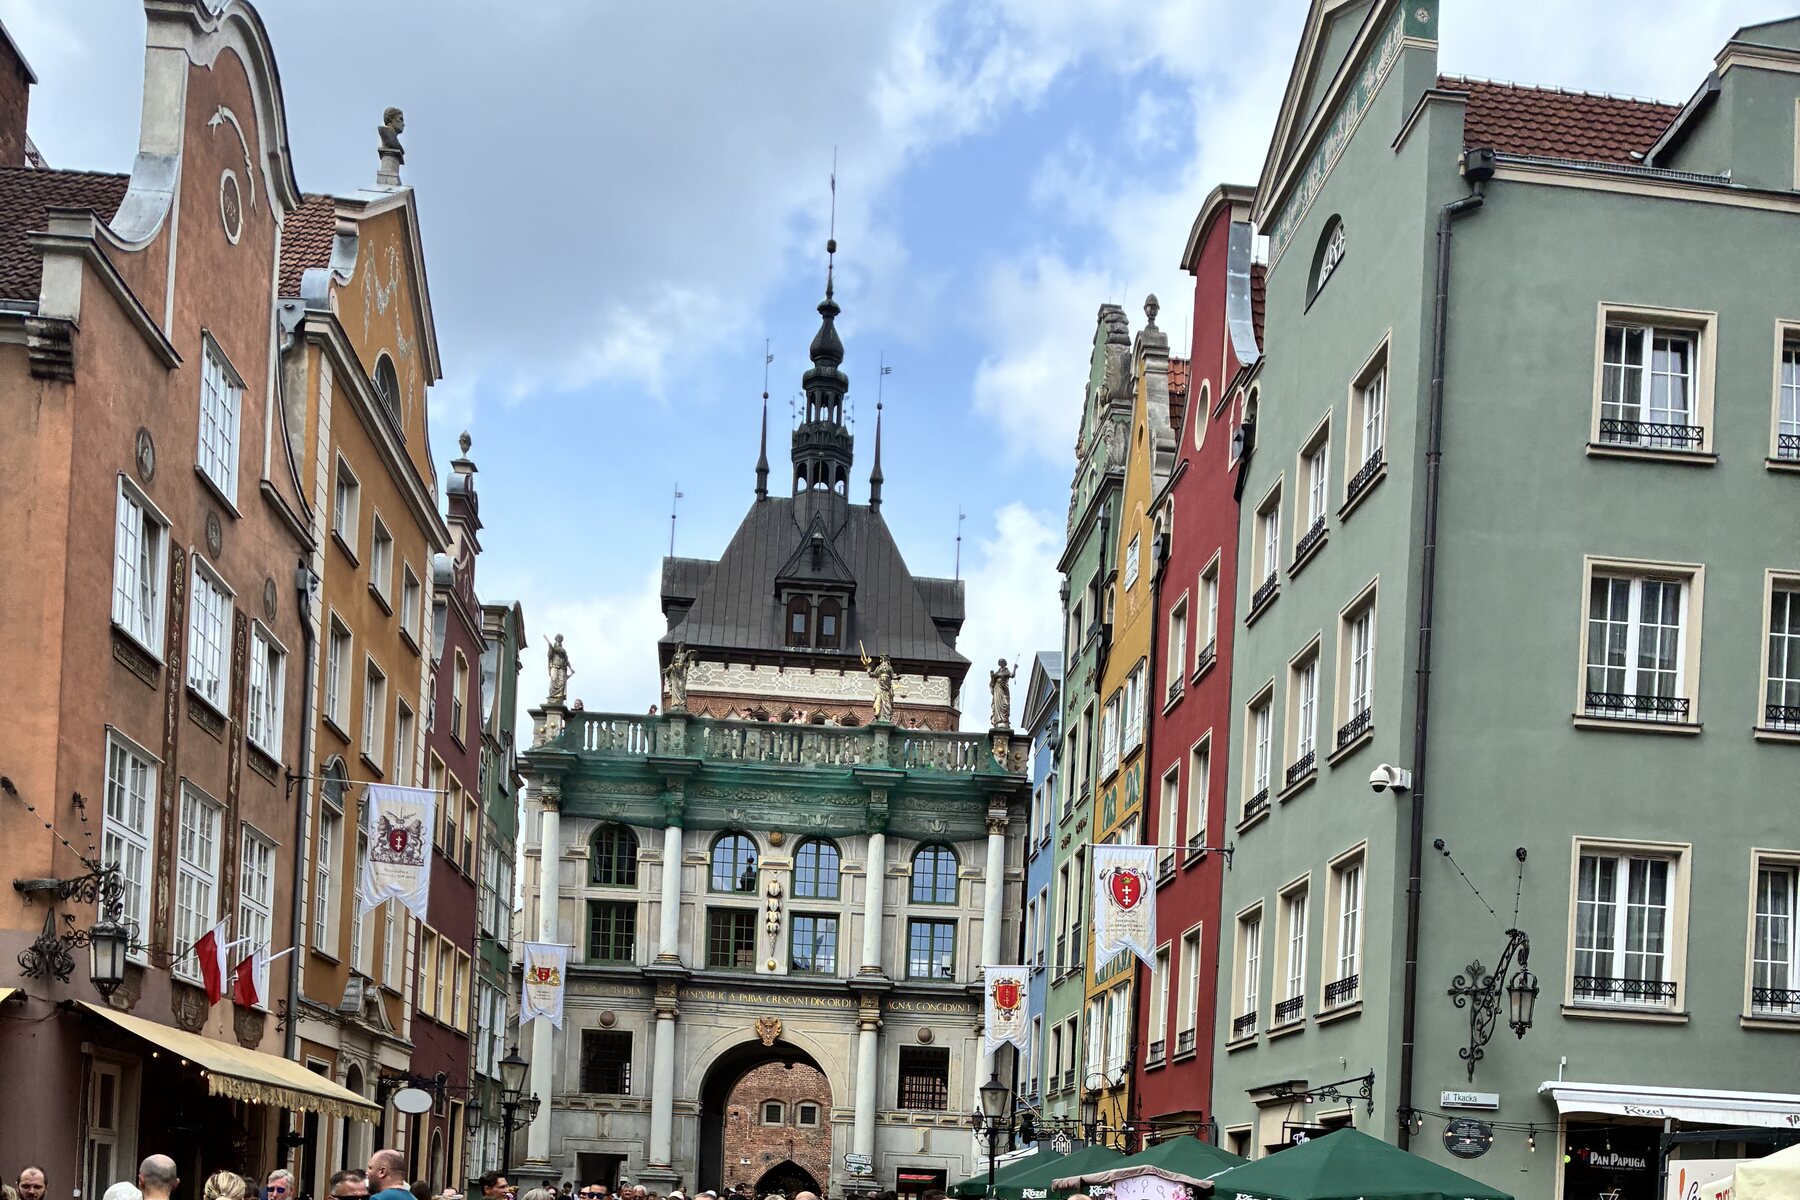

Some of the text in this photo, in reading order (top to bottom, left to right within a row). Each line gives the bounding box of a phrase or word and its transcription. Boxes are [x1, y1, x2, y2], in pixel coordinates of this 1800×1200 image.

[1623, 1105, 1665, 1116] Kozel
[1590, 1151, 1646, 1168] PAN PAPUGA
[1022, 1188, 1047, 1199] Kozel
